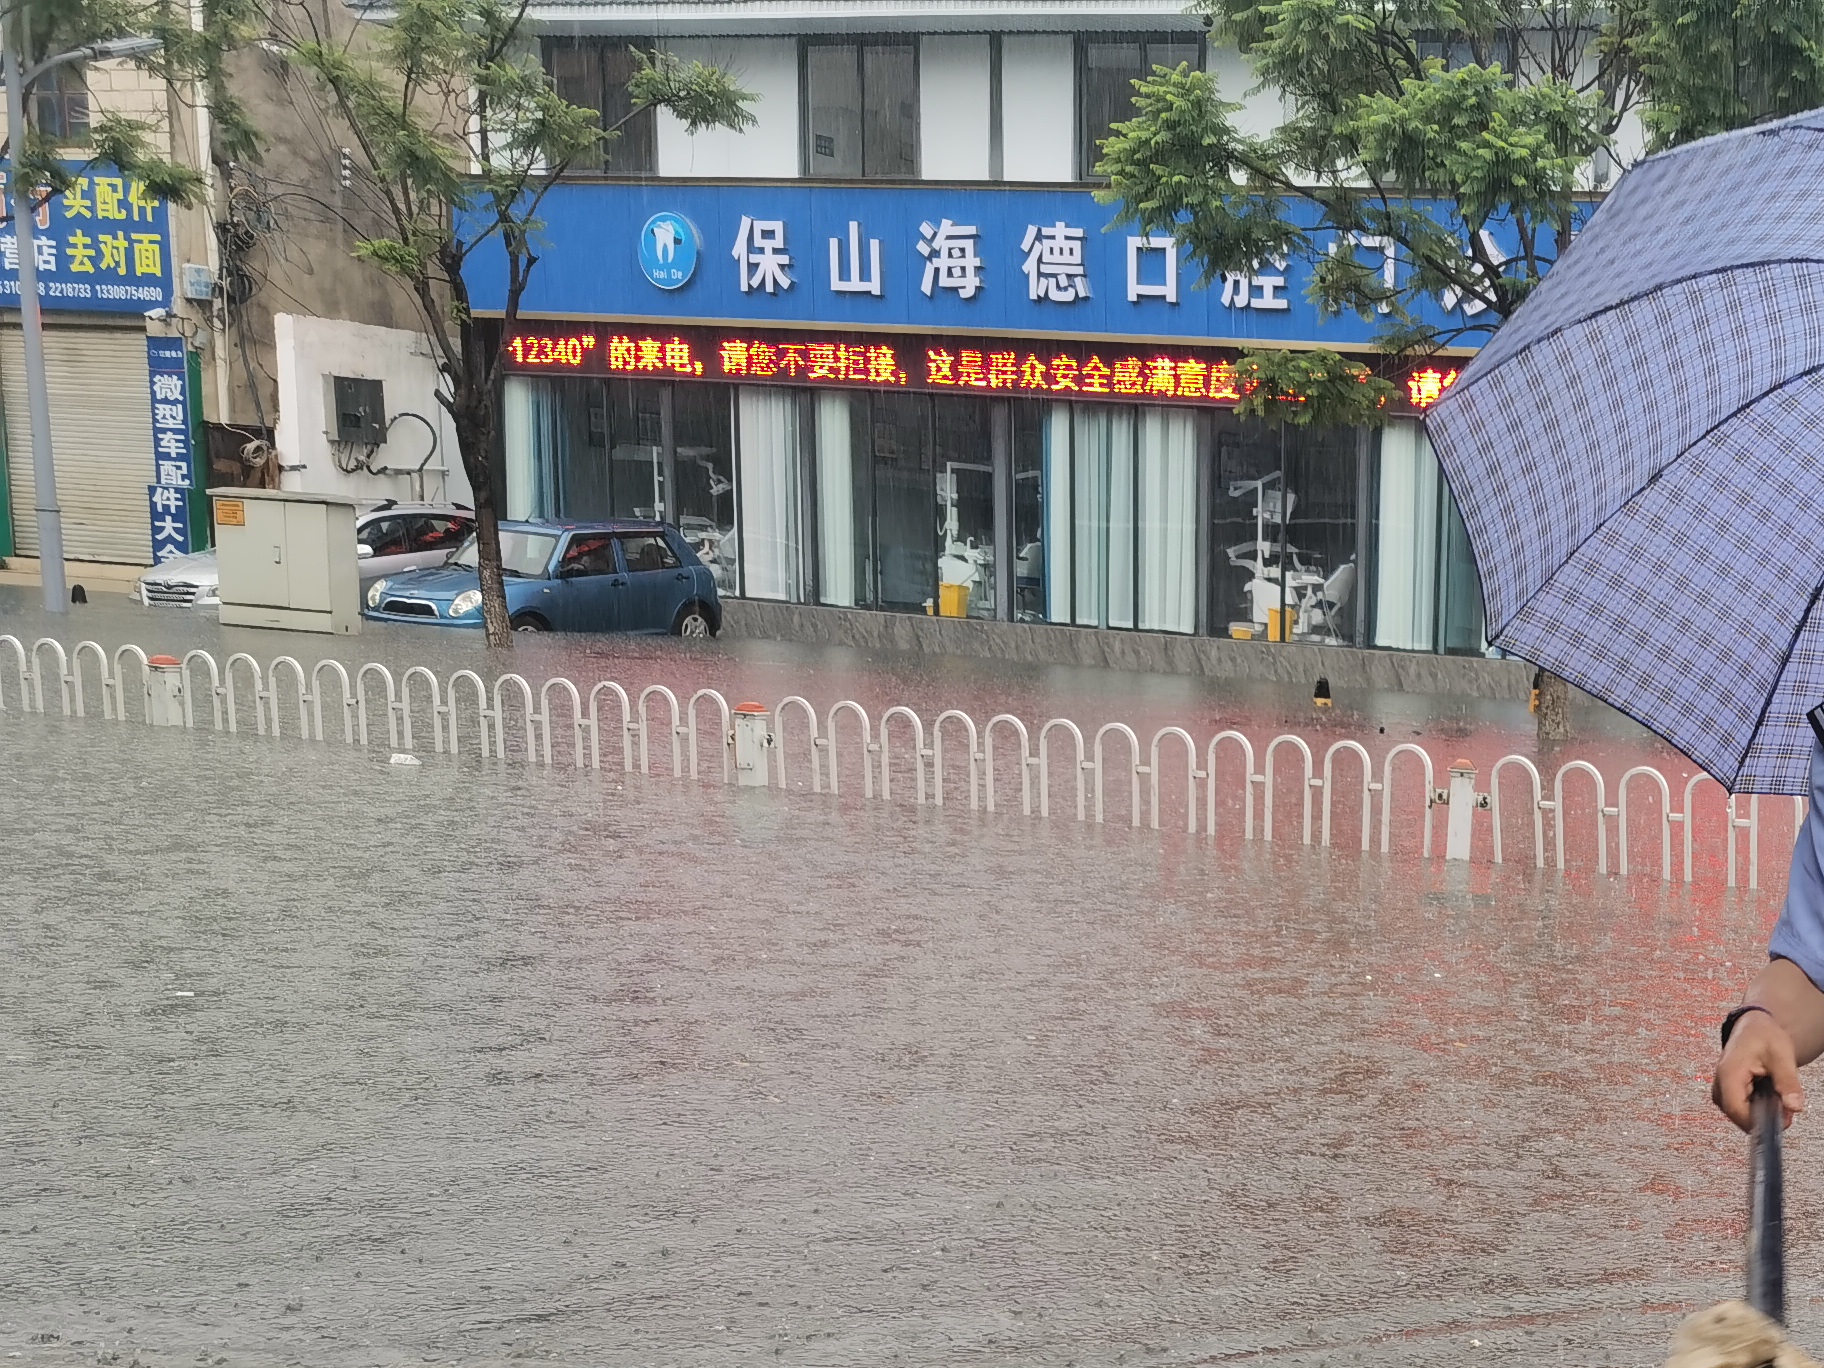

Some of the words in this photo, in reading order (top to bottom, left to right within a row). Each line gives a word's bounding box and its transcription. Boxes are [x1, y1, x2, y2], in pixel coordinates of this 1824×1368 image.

[62, 176, 160, 222] 买配件
[65, 228, 162, 277] 去对面
[49, 284, 91, 298] 2218733
[95, 285, 163, 301] 13308754690
[152, 374, 191, 565] 微型车配件大全
